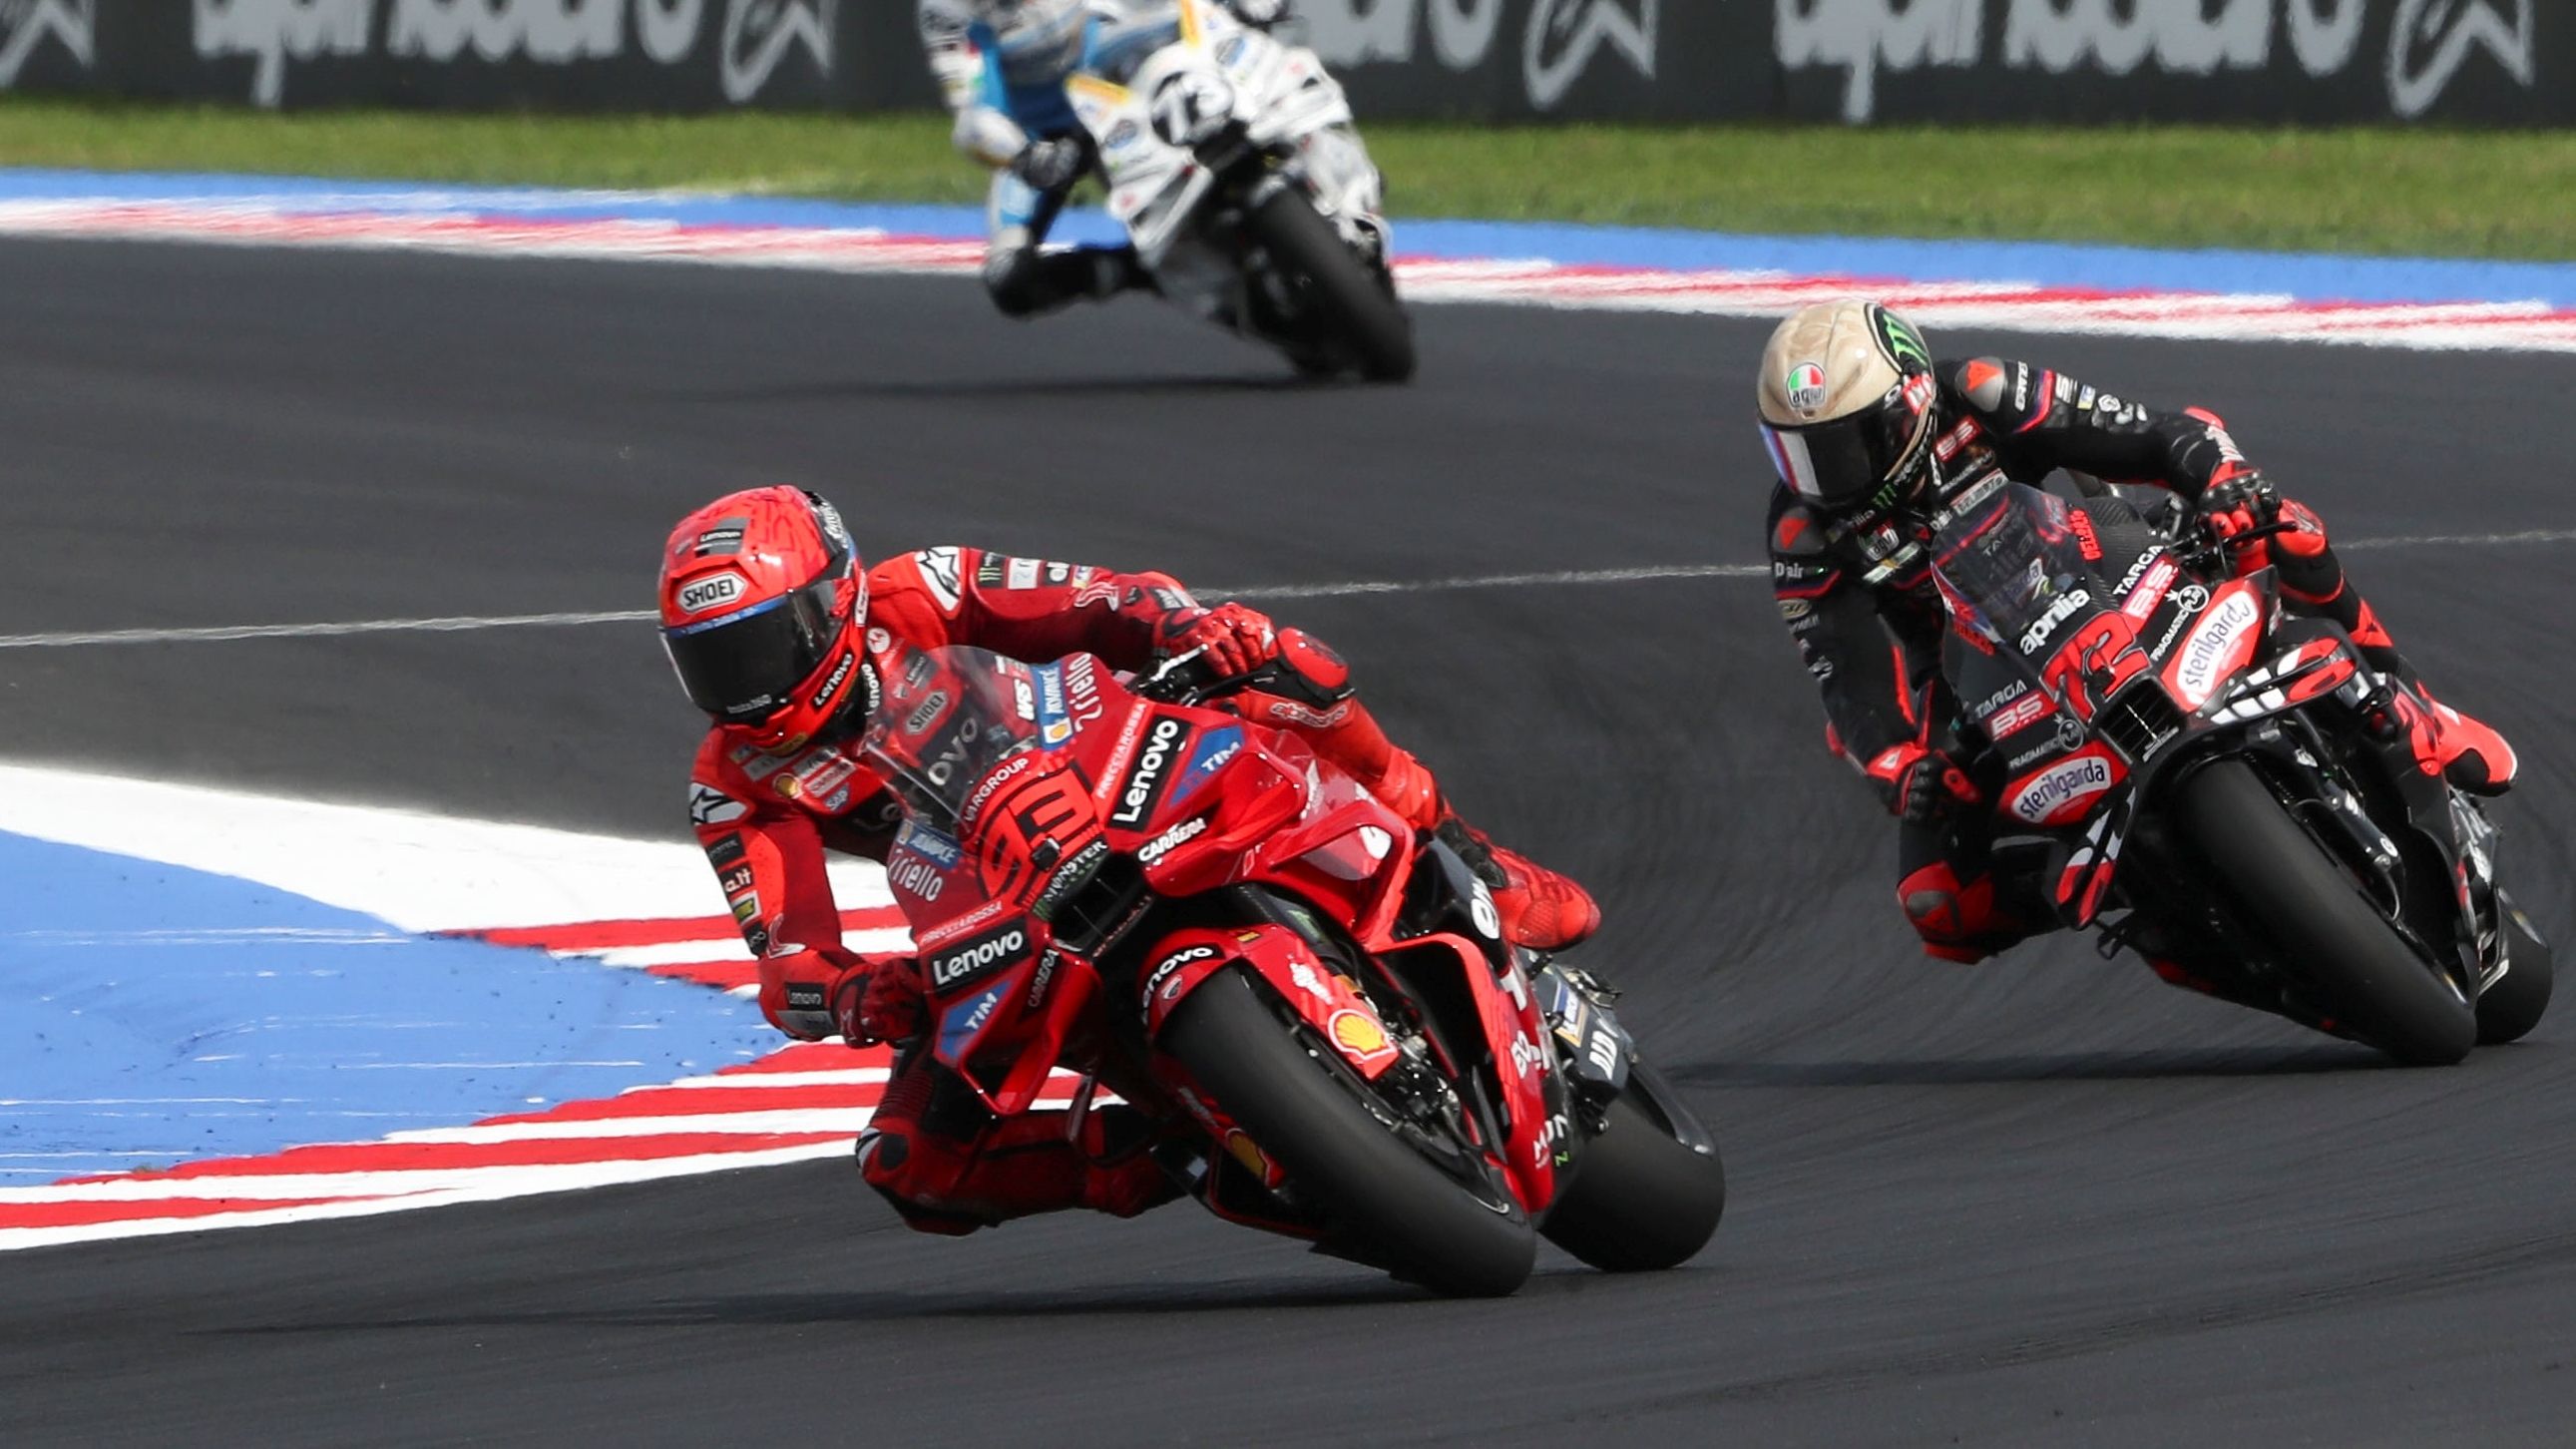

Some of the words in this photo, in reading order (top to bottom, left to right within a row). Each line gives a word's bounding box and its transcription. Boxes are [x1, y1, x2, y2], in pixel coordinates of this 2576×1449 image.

[682, 579, 735, 607] SHOEI
[2113, 546, 2164, 596] TARGA
[2125, 560, 2173, 618] BS
[2020, 589, 2090, 656] aprilia
[2150, 611, 2189, 662] PRAGMATIC
[814, 654, 853, 706] Lenovo
[2040, 611, 2151, 724] 72
[1975, 680, 2027, 719] TARGA
[1991, 695, 2043, 738] BS
[1112, 720, 1179, 822] Lenovo
[1201, 741, 1241, 772] TIM
[2020, 759, 2105, 819] sterilgarda
[980, 766, 1095, 900] 93
[1137, 817, 1206, 862] CARRERA
[933, 930, 1024, 985] Lenovo
[965, 992, 998, 1029] TIM
